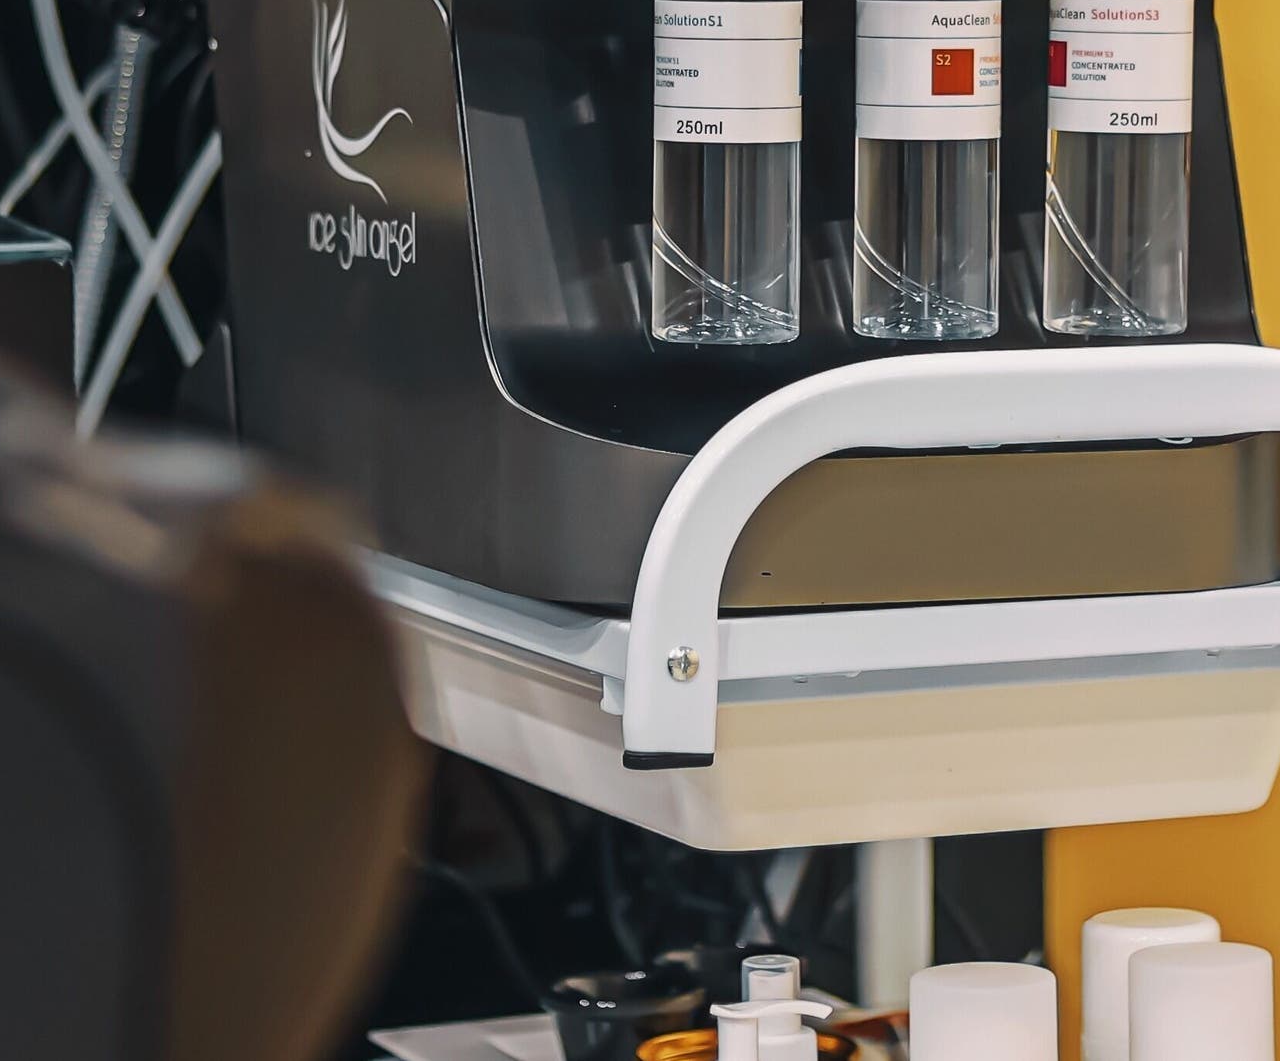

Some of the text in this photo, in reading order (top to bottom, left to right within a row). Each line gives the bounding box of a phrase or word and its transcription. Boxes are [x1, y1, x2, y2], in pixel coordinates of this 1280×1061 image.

[931, 13, 991, 29] AquaClean
[935, 54, 951, 66] S2
[1071, 61, 1136, 71] CONCENTRATED
[1071, 73, 1107, 81] SOLUTION
[1109, 112, 1158, 127] 250ml
[676, 119, 723, 135] 250ml
